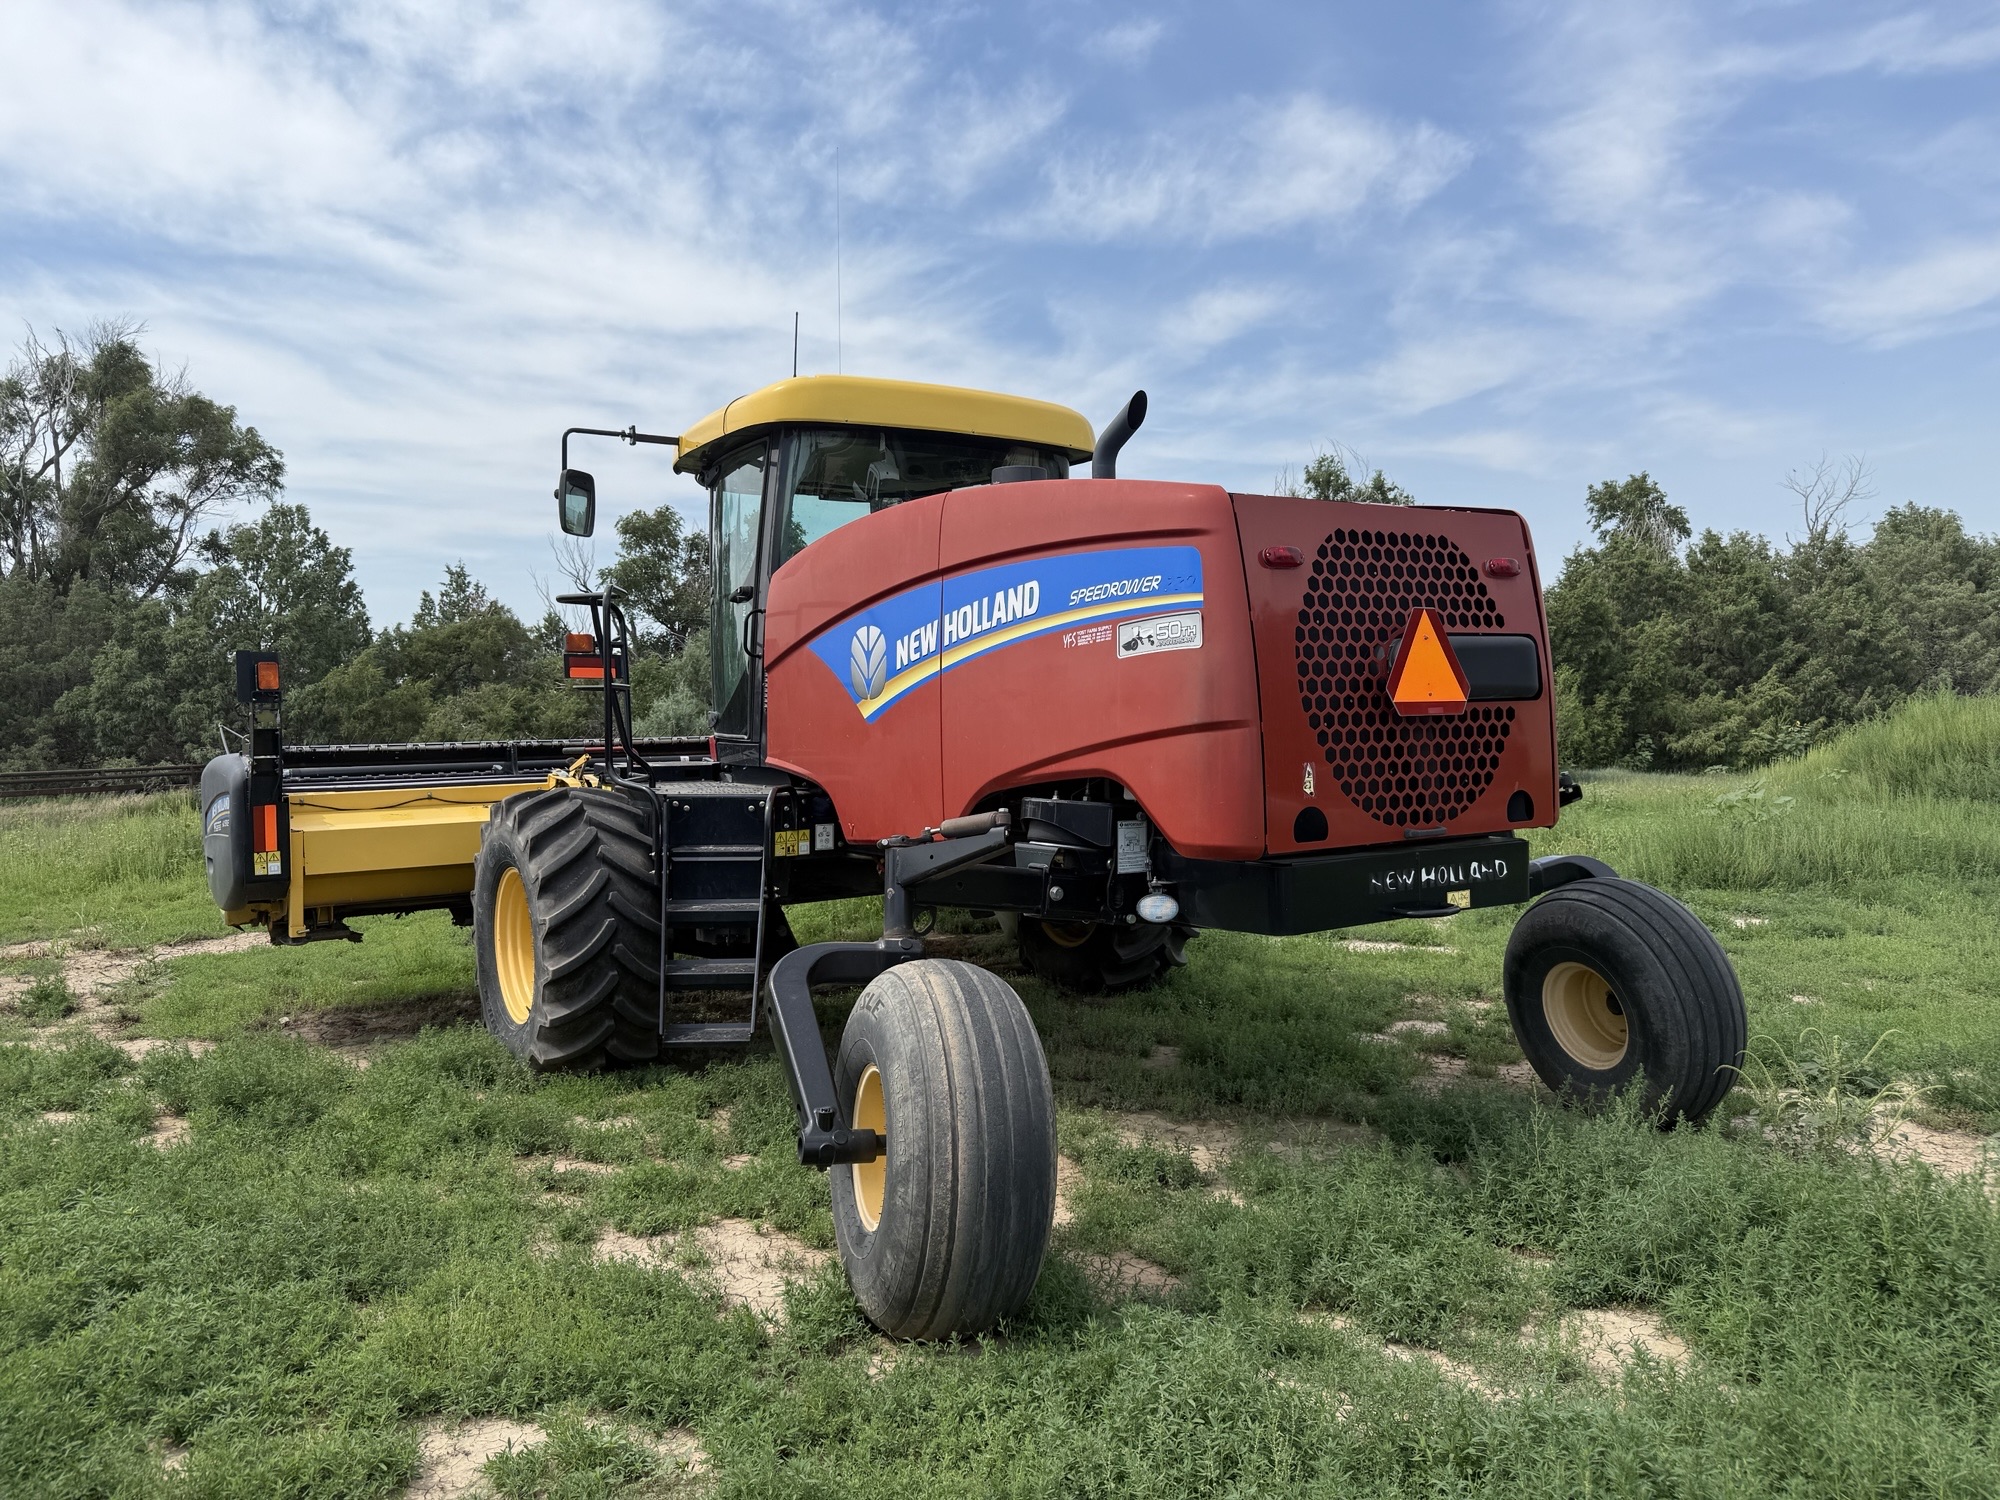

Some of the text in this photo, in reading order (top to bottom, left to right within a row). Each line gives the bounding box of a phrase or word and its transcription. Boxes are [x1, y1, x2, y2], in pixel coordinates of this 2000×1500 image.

[1069, 575, 1162, 606] SPEEDROWER
[896, 580, 1040, 671] NEW HOLLAND
[1156, 620, 1196, 640] 50TH
[1063, 632, 1076, 648] YFS
